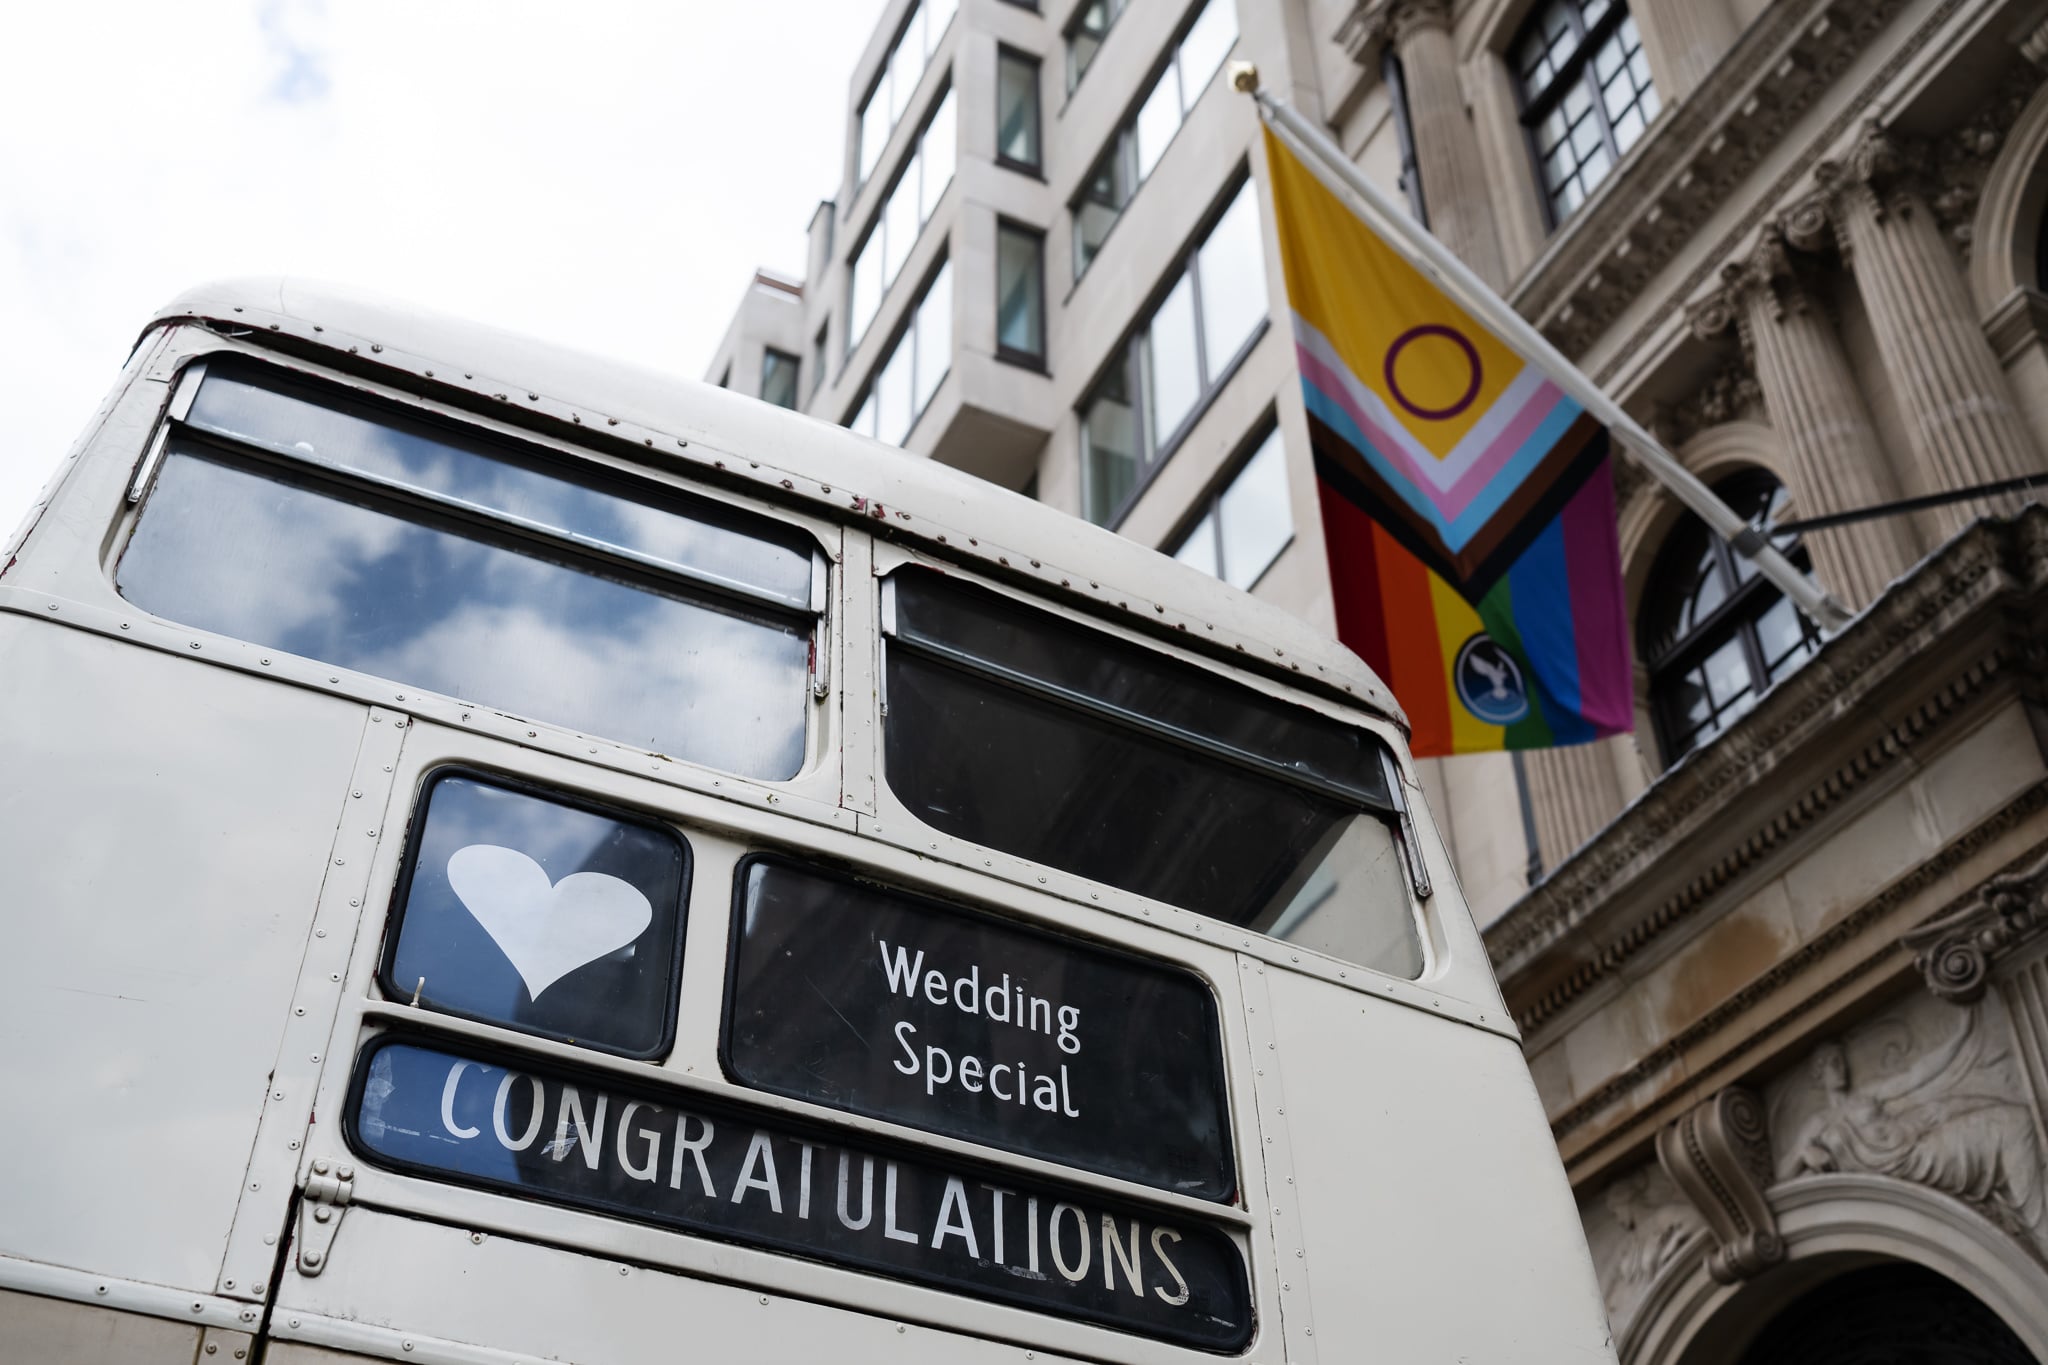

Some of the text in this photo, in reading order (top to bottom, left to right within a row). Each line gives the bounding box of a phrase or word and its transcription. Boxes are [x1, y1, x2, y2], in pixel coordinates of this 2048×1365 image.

[880, 940, 1081, 1054] Wedding
[893, 1021, 1080, 1118] Special
[441, 1058, 1189, 1306] CONGRATULATIONS
